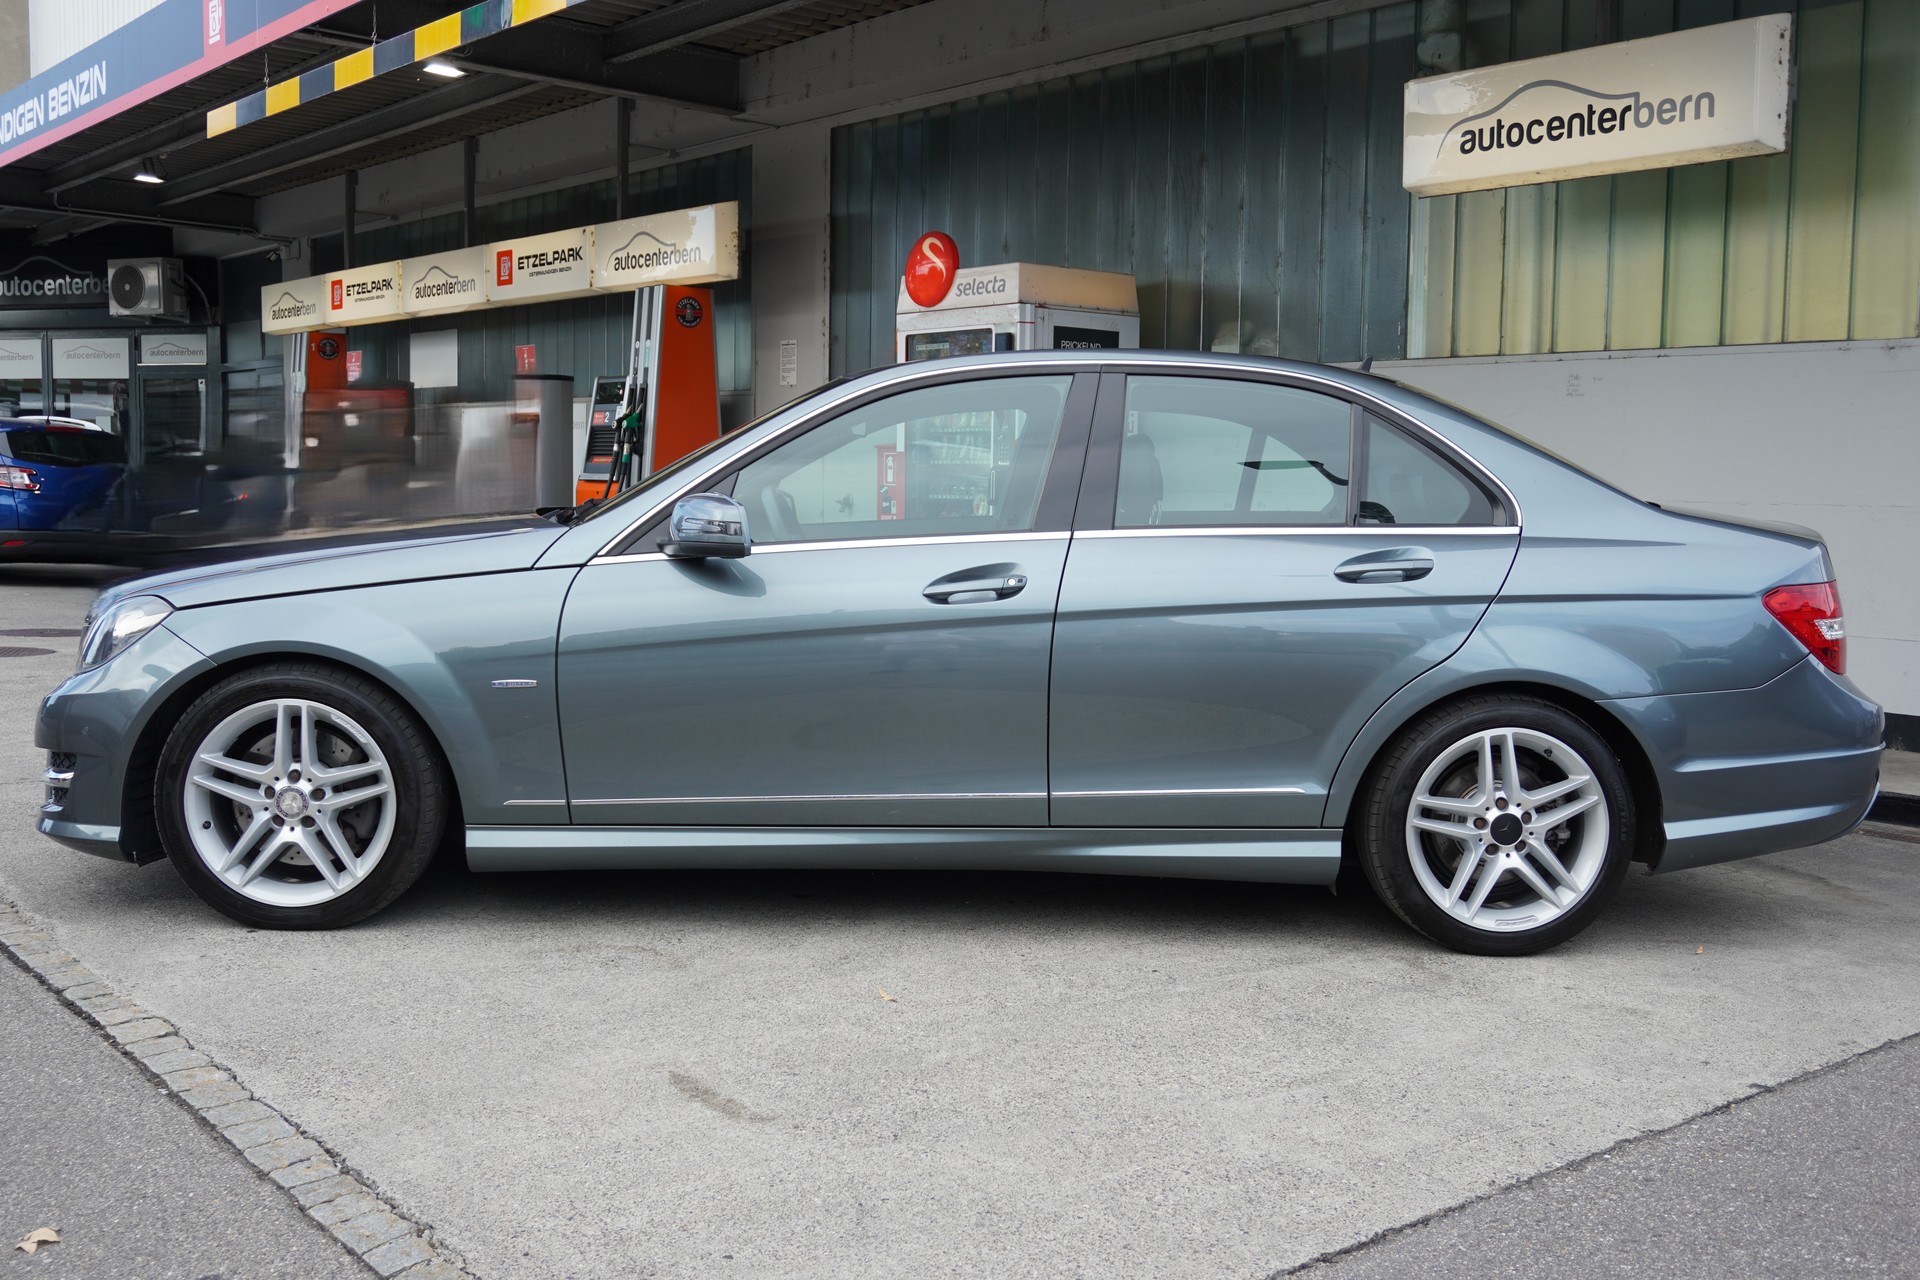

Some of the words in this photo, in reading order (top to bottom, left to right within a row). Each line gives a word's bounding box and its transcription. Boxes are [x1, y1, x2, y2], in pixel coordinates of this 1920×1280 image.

[48, 60, 106, 121] BENZIN
[1460, 91, 1715, 155] autocenterbern
[518, 246, 583, 270] ETZELPARK
[614, 246, 701, 271] autocenterbern
[346, 278, 393, 296] ETZELPARK
[414, 278, 476, 299] autocenterbern
[956, 275, 1006, 297] selecta
[272, 303, 316, 320] autocenterbern
[66, 350, 120, 360] autocenterbern
[149, 348, 204, 357] autocenterbern
[311, 343, 315, 351] 1
[604, 411, 610, 423] 2
